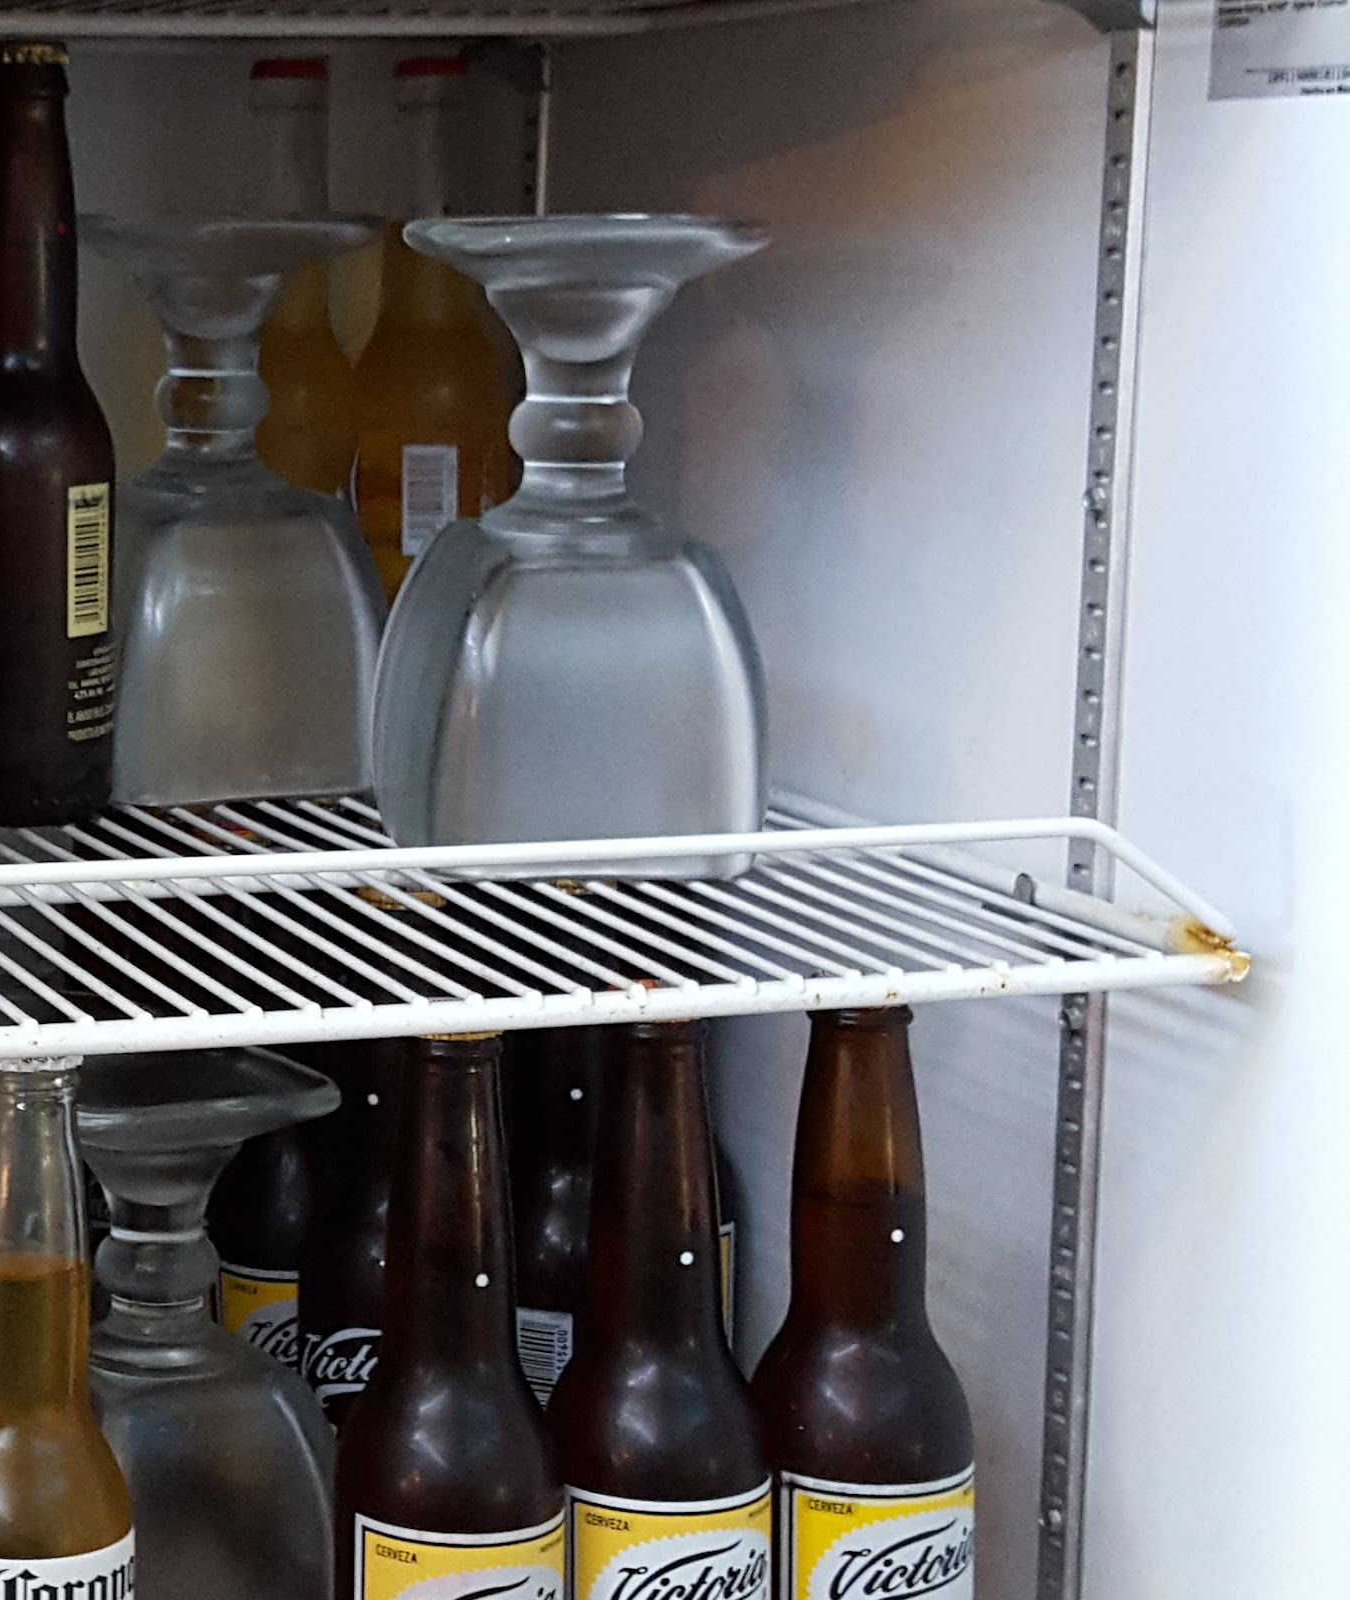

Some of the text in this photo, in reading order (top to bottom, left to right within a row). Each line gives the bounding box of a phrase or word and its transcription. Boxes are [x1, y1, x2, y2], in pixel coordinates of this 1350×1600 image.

[298, 1326, 385, 1402] Vict
[808, 1498, 853, 1516] CERVEZA
[585, 1511, 631, 1533] CERVEZA
[375, 1542, 418, 1564] CERVEZA
